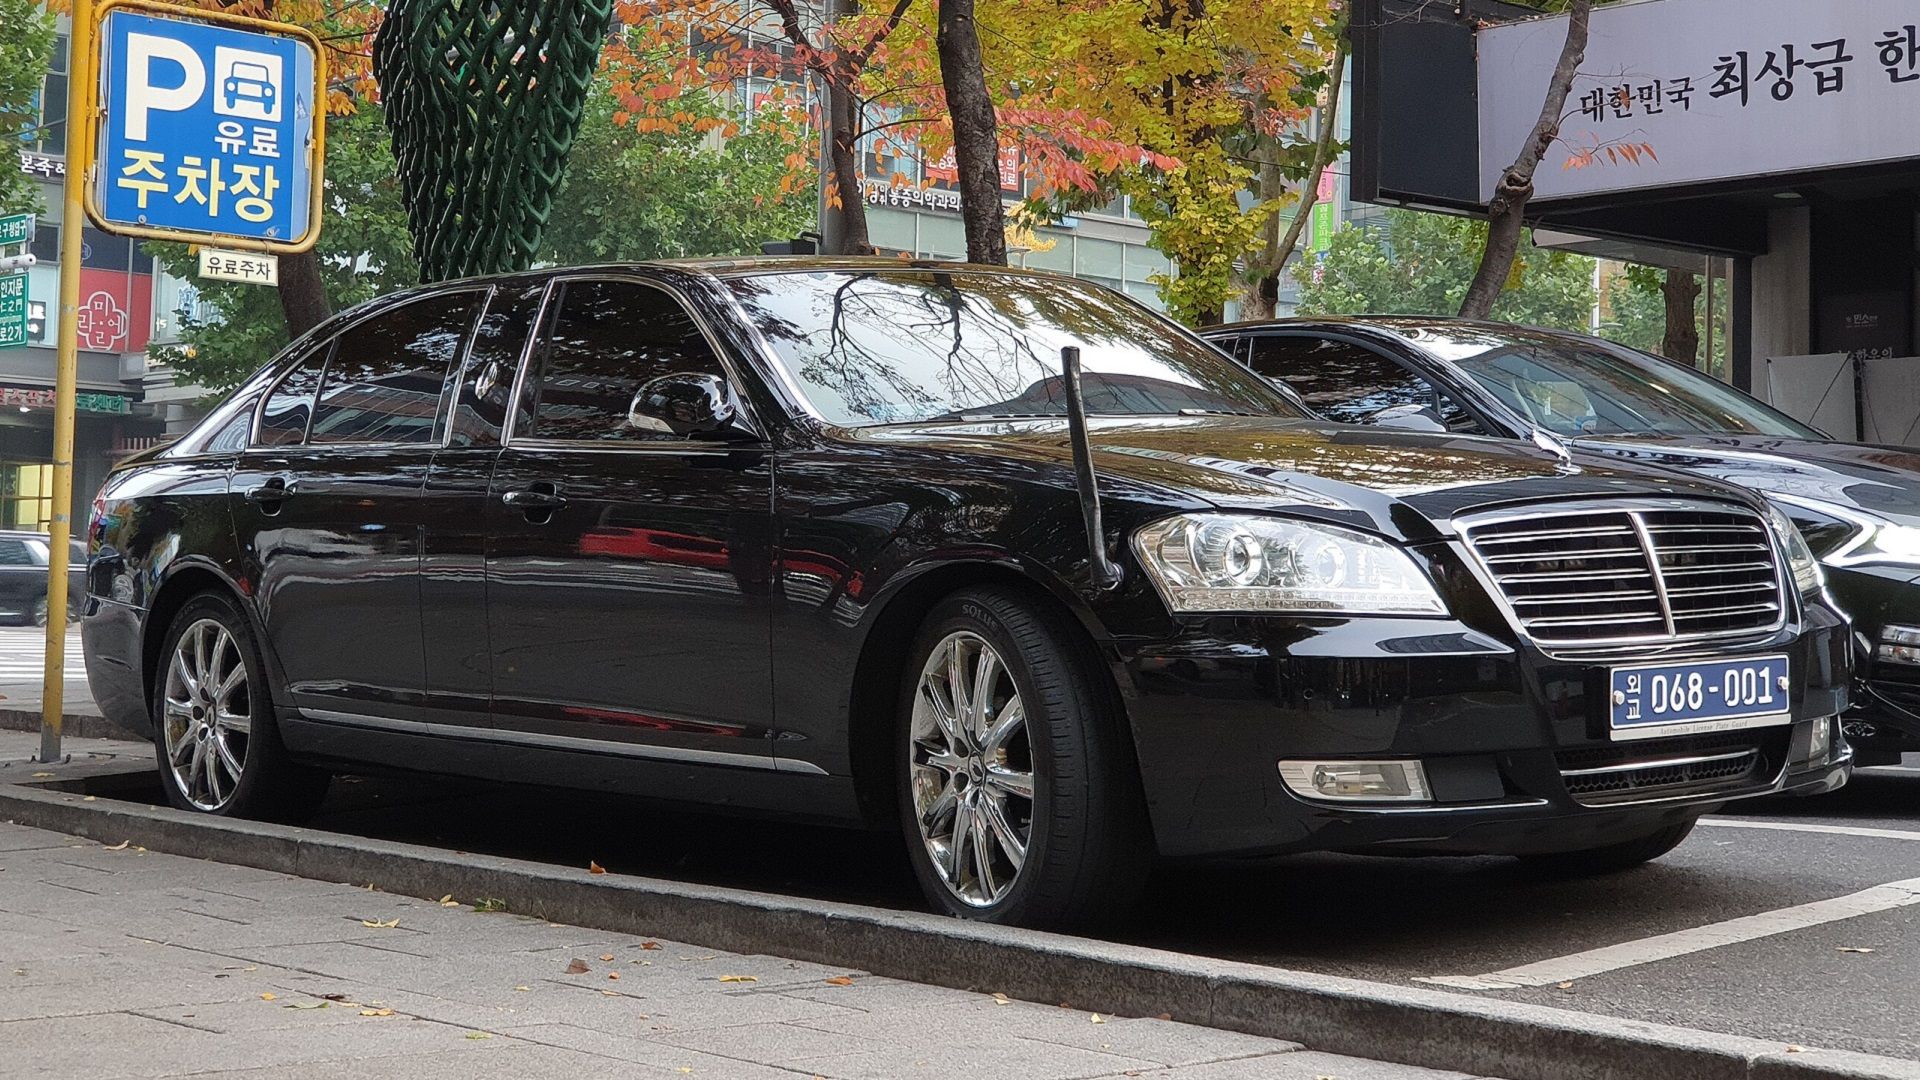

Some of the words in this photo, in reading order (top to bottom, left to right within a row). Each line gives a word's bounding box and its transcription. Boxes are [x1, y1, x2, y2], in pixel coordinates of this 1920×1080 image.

[125, 31, 206, 142] P
[1579, 77, 1695, 123] 대한민국
[1709, 38, 1853, 107] 최상급
[214, 121, 281, 159] 유료
[117, 149, 280, 223] 주차장
[0, 220, 27, 238] 구청입구
[206, 255, 272, 281] 유료주차
[961, 603, 999, 631] SOLUS
[1626, 673, 1642, 720] 외교
[1650, 666, 1773, 714] 068-001
